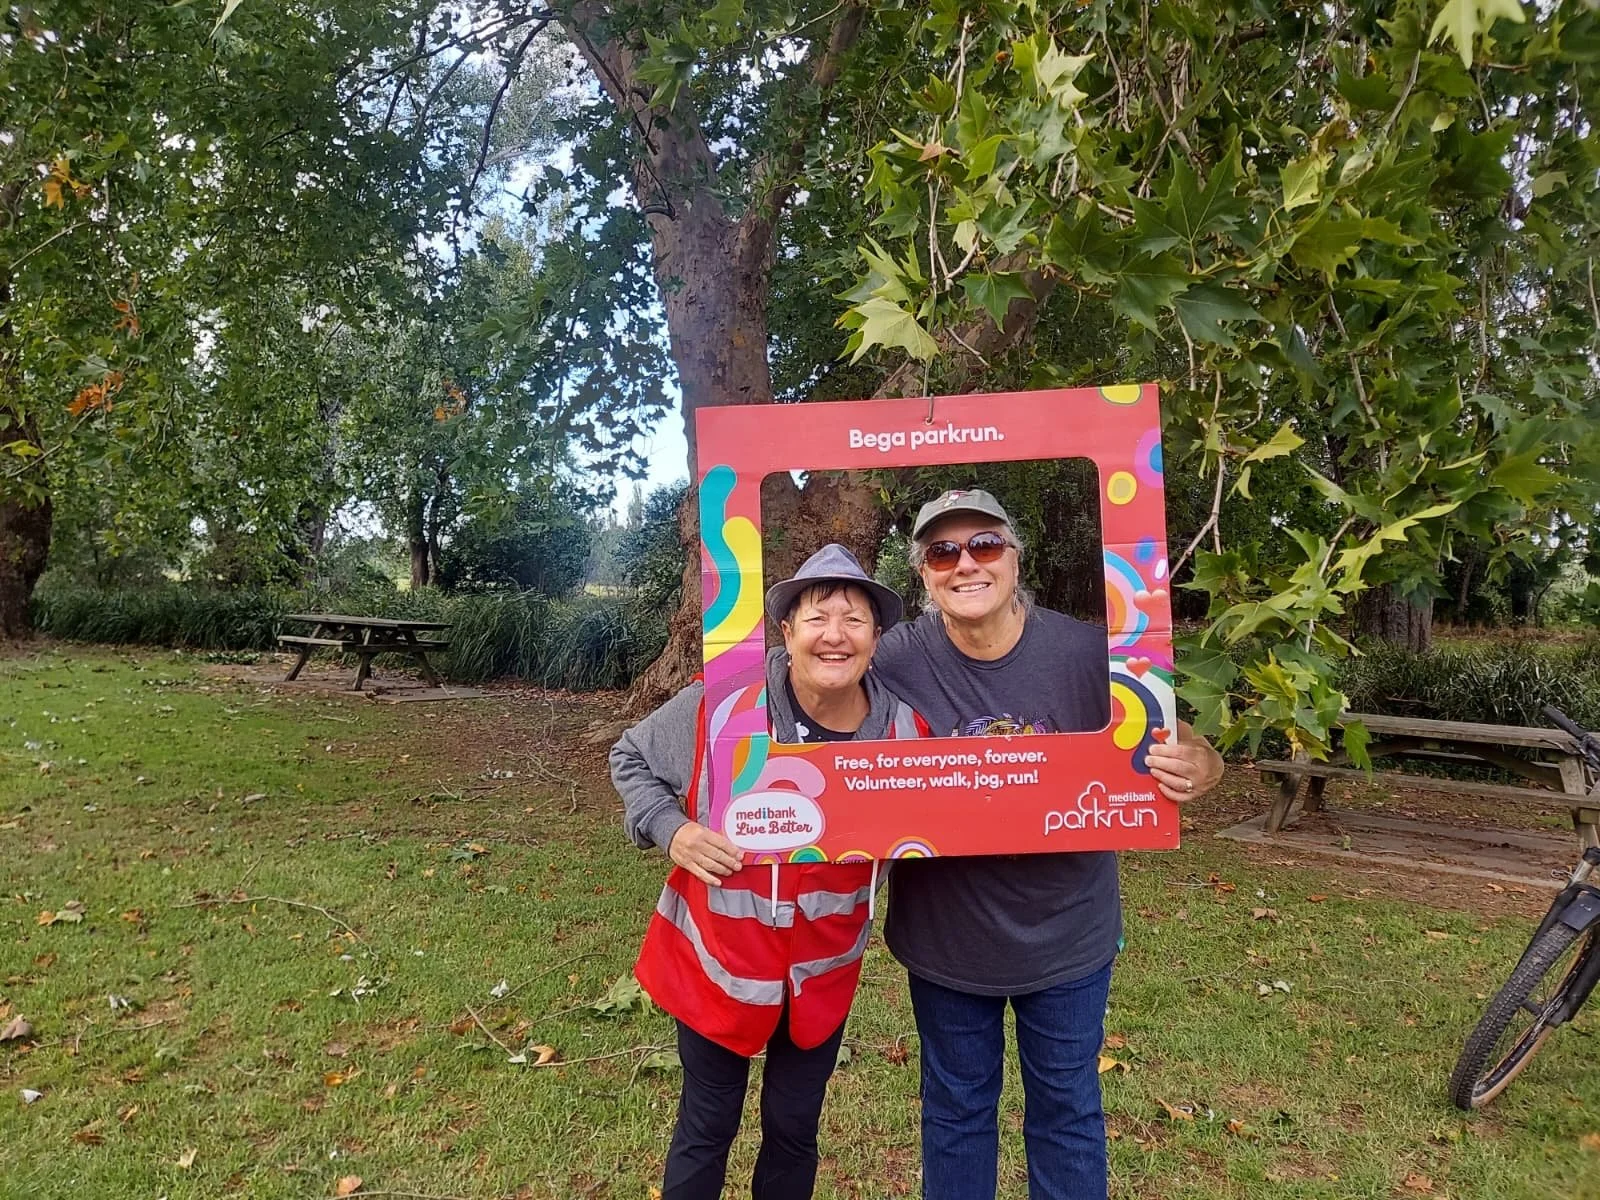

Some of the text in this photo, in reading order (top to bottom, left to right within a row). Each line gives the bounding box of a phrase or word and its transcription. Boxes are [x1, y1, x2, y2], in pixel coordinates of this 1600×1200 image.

[849, 423, 1005, 452] Bega parkrun.
[834, 748, 1048, 771] Free, for everyone, forever.
[844, 769, 1039, 791] Volunteer, walk, jog, run!
[1108, 792, 1156, 803] medibank
[736, 806, 797, 820] medibank
[1044, 796, 1158, 836] parkrun
[735, 820, 813, 836] Live Better
